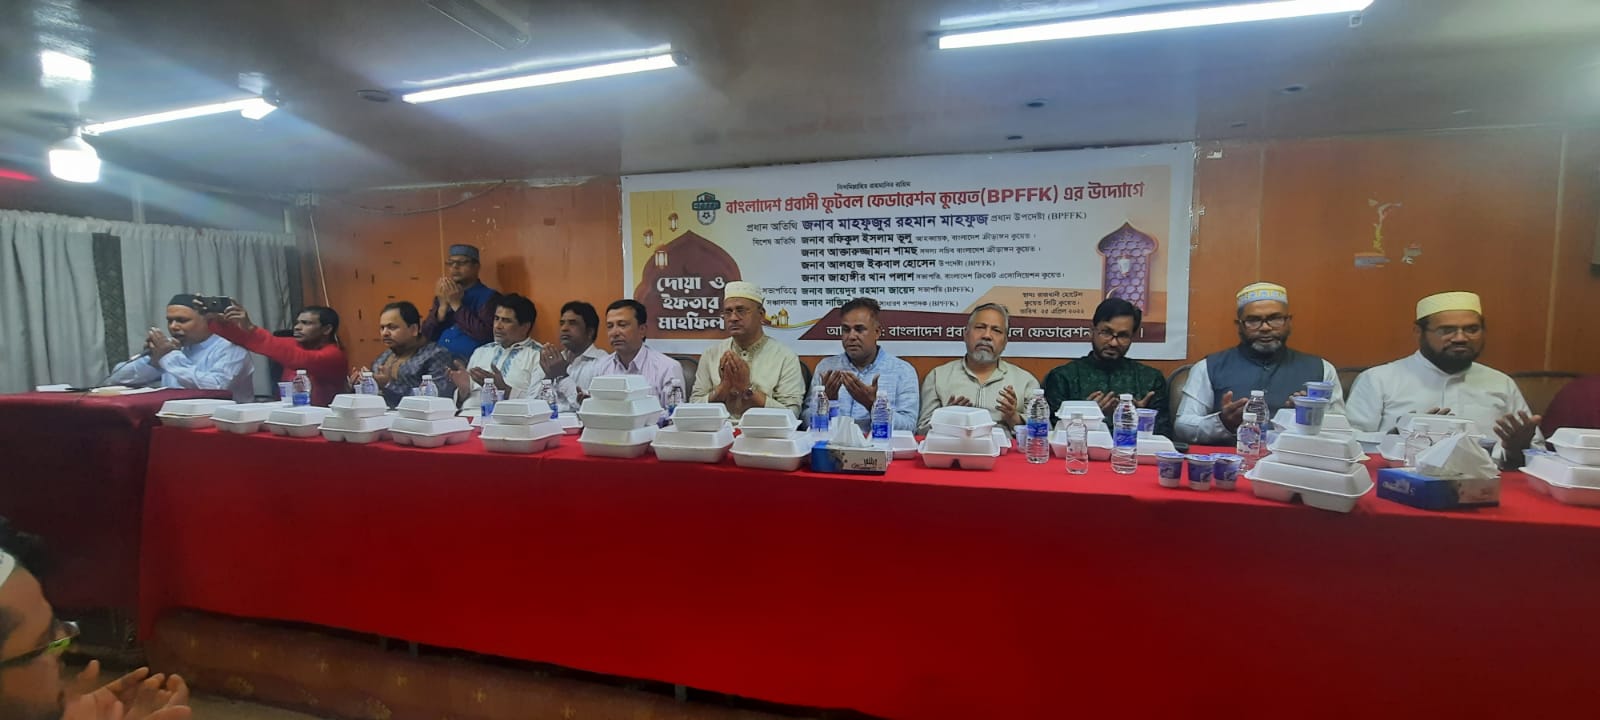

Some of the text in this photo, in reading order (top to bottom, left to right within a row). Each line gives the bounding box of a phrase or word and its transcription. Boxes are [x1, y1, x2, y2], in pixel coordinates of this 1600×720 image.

[725, 198, 782, 214] বাংলাদেশ
[785, 192, 819, 212] প্রবাসী
[867, 190, 937, 208] ফেডারেশন
[1063, 185, 1084, 201] এর
[1088, 180, 1145, 200] উদ্যোগে
[746, 222, 768, 232] প্রধান
[771, 220, 798, 231] অতিথি
[801, 219, 834, 231] জনাব
[838, 217, 891, 232] মাহফুজুর
[895, 215, 936, 228] রহমান
[940, 214, 989, 228] মাহফুজ
[991, 214, 1011, 222] প্রধান
[1048, 211, 1087, 221] (BPFFK)
[752, 237, 771, 246] বিশেষ
[774, 235, 796, 245] অতিথি
[801, 235, 824, 244] জনাব
[827, 232, 859, 245] রফিকুল
[861, 232, 894, 243] ইসলাম
[952, 234, 979, 242] বাংলাদেশ
[801, 248, 824, 257] জনাব
[801, 260, 824, 269] জনাব
[827, 260, 864, 269] আলহাজ
[867, 258, 900, 269] ইকবাল
[902, 259, 936, 268] হোসেন
[801, 273, 825, 282] জনাব
[868, 272, 886, 281] খান
[889, 272, 914, 281] পলাশ
[656, 276, 726, 293] দোয়া ও
[801, 287, 823, 295] জনাব
[859, 286, 885, 295] রহমান
[888, 286, 915, 295] জায়েদ
[663, 294, 719, 313] ইফতার
[801, 299, 823, 307] জনাব
[658, 312, 726, 331] মাহফিল
[888, 326, 942, 337] বাংলাদেশ
